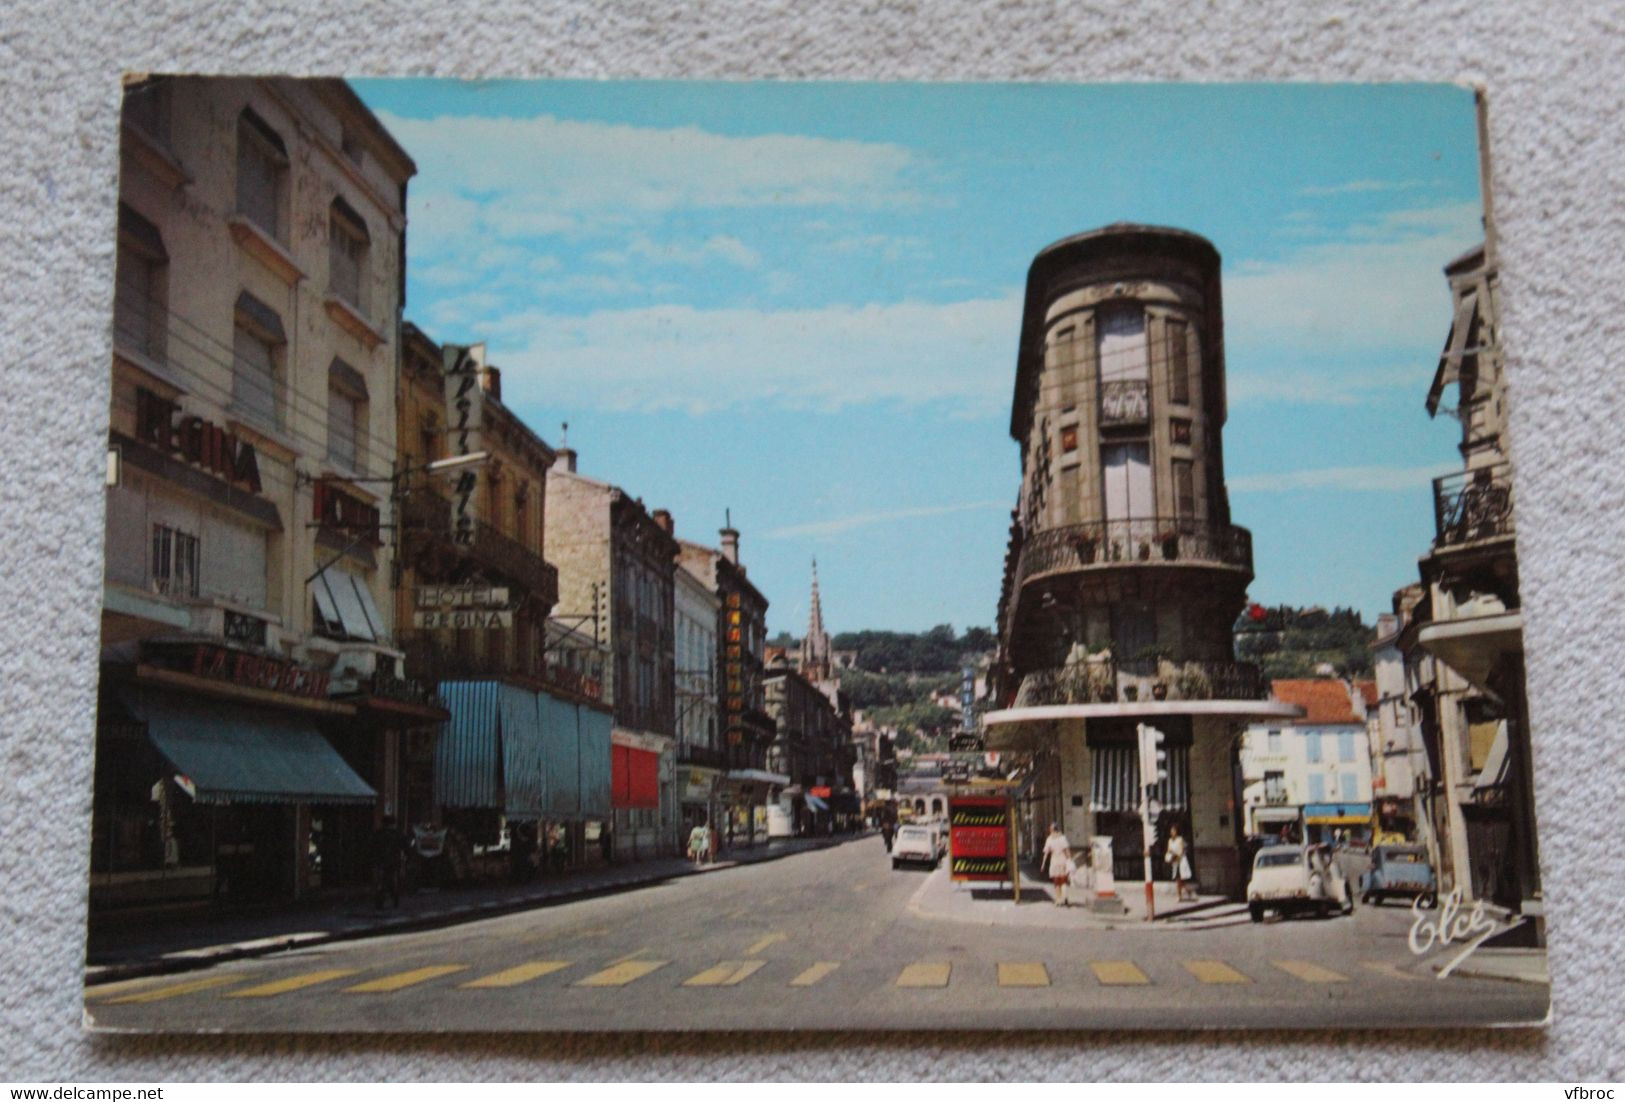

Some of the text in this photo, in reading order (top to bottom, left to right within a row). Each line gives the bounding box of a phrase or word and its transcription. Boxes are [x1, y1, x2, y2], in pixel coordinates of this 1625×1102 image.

[423, 586, 505, 605] HOTEL
[423, 611, 503, 629] REGINA
[953, 811, 1006, 825] Brandt
[953, 859, 1006, 873] Brandt
